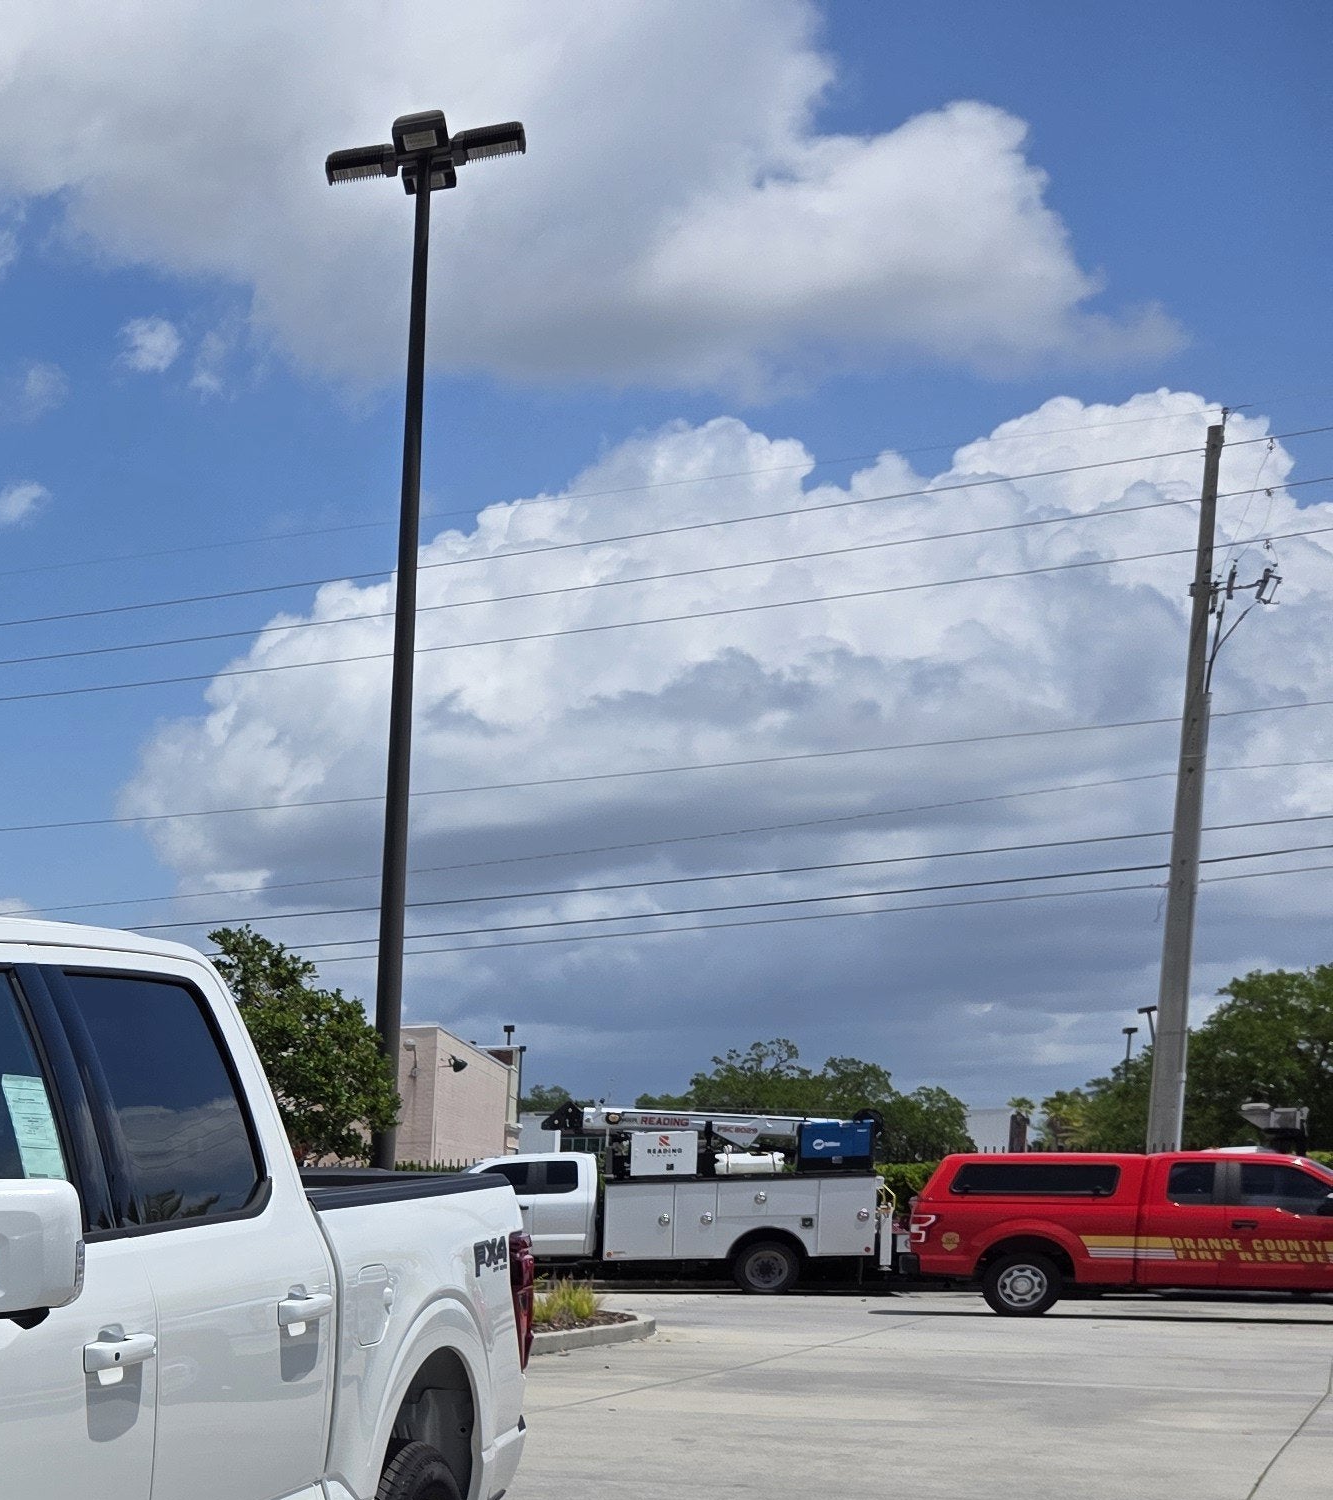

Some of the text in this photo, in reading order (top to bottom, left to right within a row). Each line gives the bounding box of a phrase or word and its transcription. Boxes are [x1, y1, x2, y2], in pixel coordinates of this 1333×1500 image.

[640, 1116, 690, 1127] READING
[647, 1147, 683, 1155] READING
[1171, 1237, 1324, 1252] ORANGE COUNTY
[1175, 1250, 1329, 1263] FIRE RESCUE
